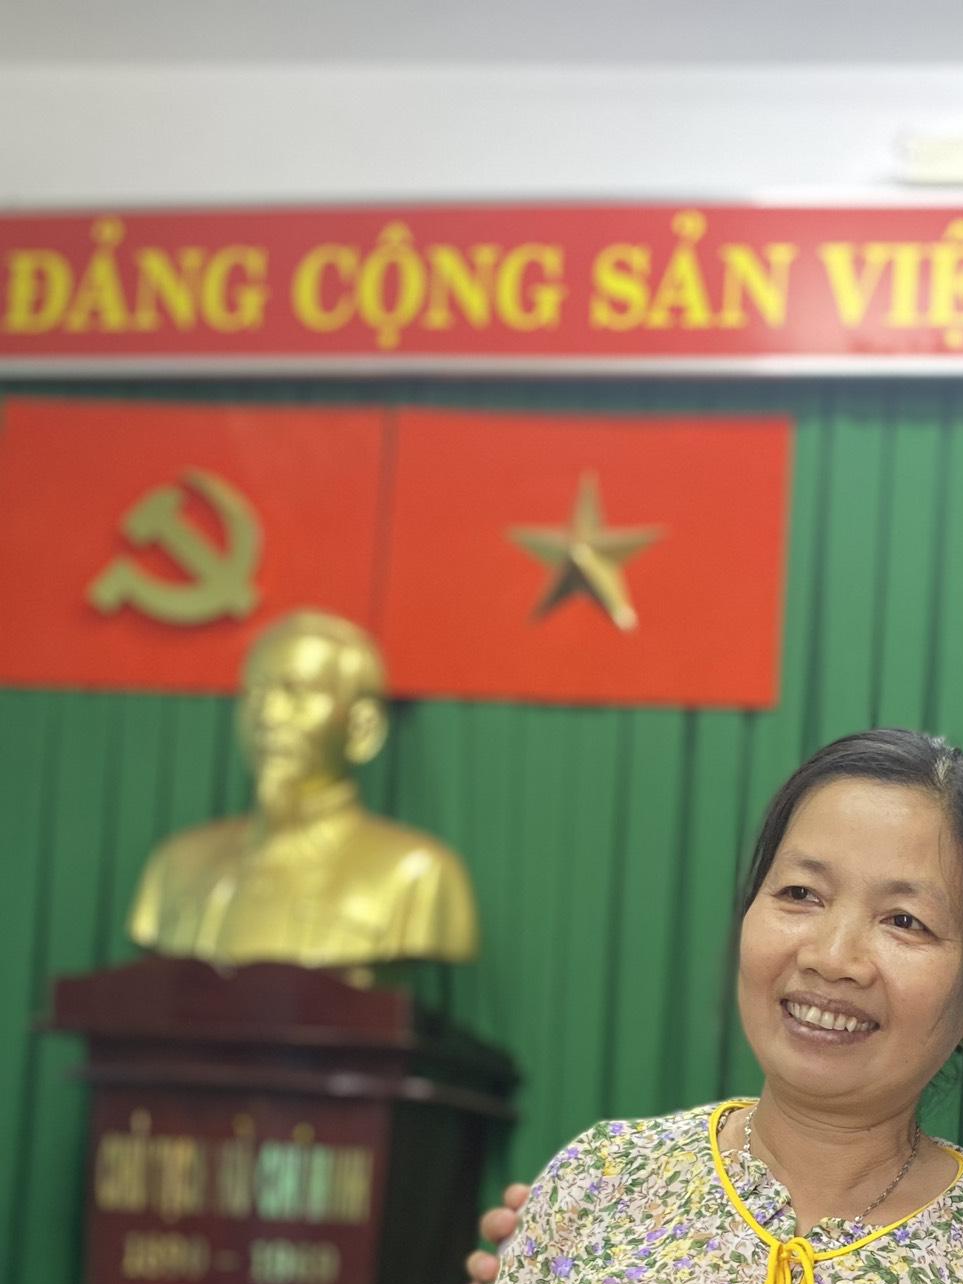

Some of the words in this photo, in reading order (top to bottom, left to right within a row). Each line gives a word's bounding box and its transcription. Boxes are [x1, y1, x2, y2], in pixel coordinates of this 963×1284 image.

[4, 216, 270, 335] ĐẢNG
[291, 220, 564, 350] CỘNG
[589, 210, 797, 331] SẢN
